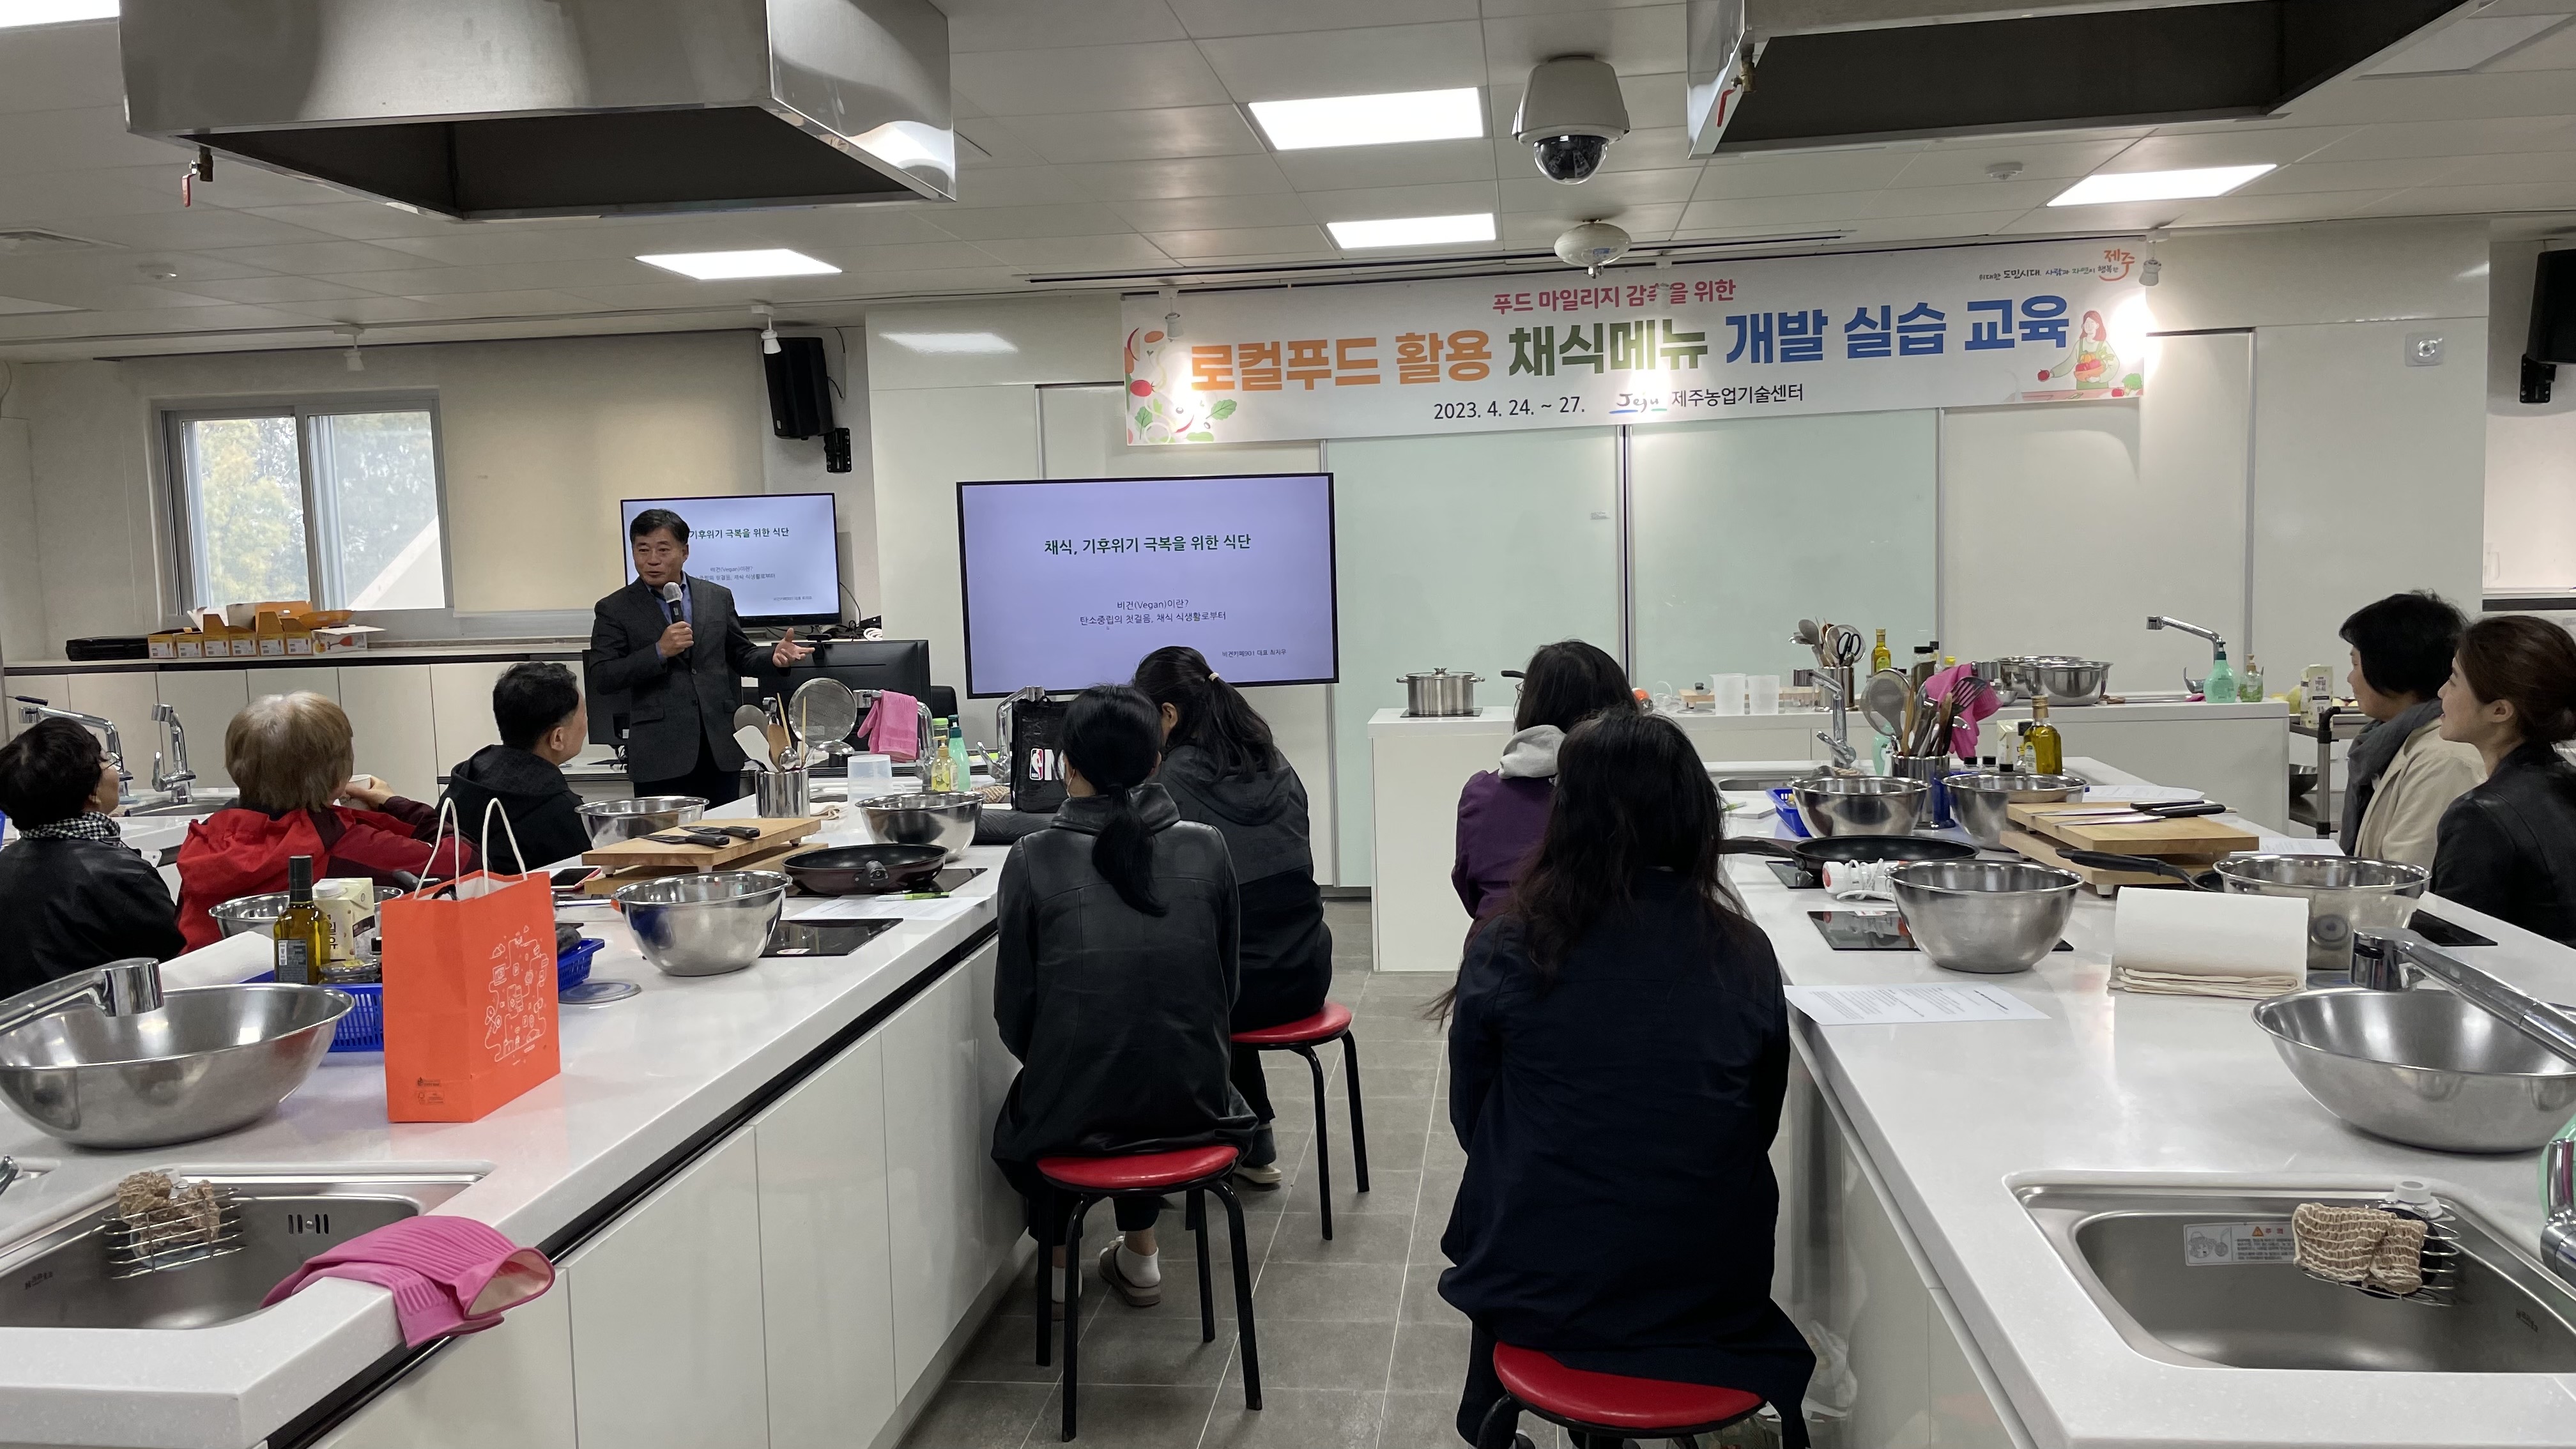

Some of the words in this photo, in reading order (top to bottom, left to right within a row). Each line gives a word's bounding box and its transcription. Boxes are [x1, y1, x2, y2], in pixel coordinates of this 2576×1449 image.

[2097, 264, 2119, 273] 행복한
[2103, 249, 2136, 273] 제주
[1979, 273, 2002, 281] 위대한
[2045, 268, 2069, 277] 사람과
[1492, 293, 1533, 315] 푸드
[1538, 286, 1620, 312] 마일리지
[1694, 279, 1736, 302] 위한
[1191, 337, 1381, 390] 로컬푸드
[1395, 329, 1492, 385] 활용
[1508, 318, 1708, 377] 채식메뉴
[1725, 309, 1828, 365] 개발
[1844, 302, 1949, 359] 실습
[1964, 295, 2070, 352] 교육
[1616, 391, 1659, 413] Jeju
[1671, 383, 1804, 409] 제주농업기술센터
[1434, 402, 1481, 420] 2023.
[1487, 401, 1502, 417] 4.
[1508, 399, 1534, 416] 24.
[1559, 396, 1584, 413] 27.
[691, 529, 723, 540] 기후위기
[725, 528, 751, 539] 극복을
[753, 528, 770, 537] 위한
[772, 527, 789, 537] 식단
[1045, 539, 1078, 555] 채식,
[1082, 537, 1138, 554] 기후위기
[1144, 536, 1186, 552] 극복을
[1191, 535, 1219, 551] 위한
[1223, 533, 1252, 549] 식단
[1117, 599, 1189, 611] 비건(Vegan)이란?
[1080, 615, 1123, 626] 탄소중립의
[1126, 613, 1154, 624] 첫걸음,
[1156, 613, 1173, 623] 채식
[1176, 611, 1226, 622] 식생활로부터
